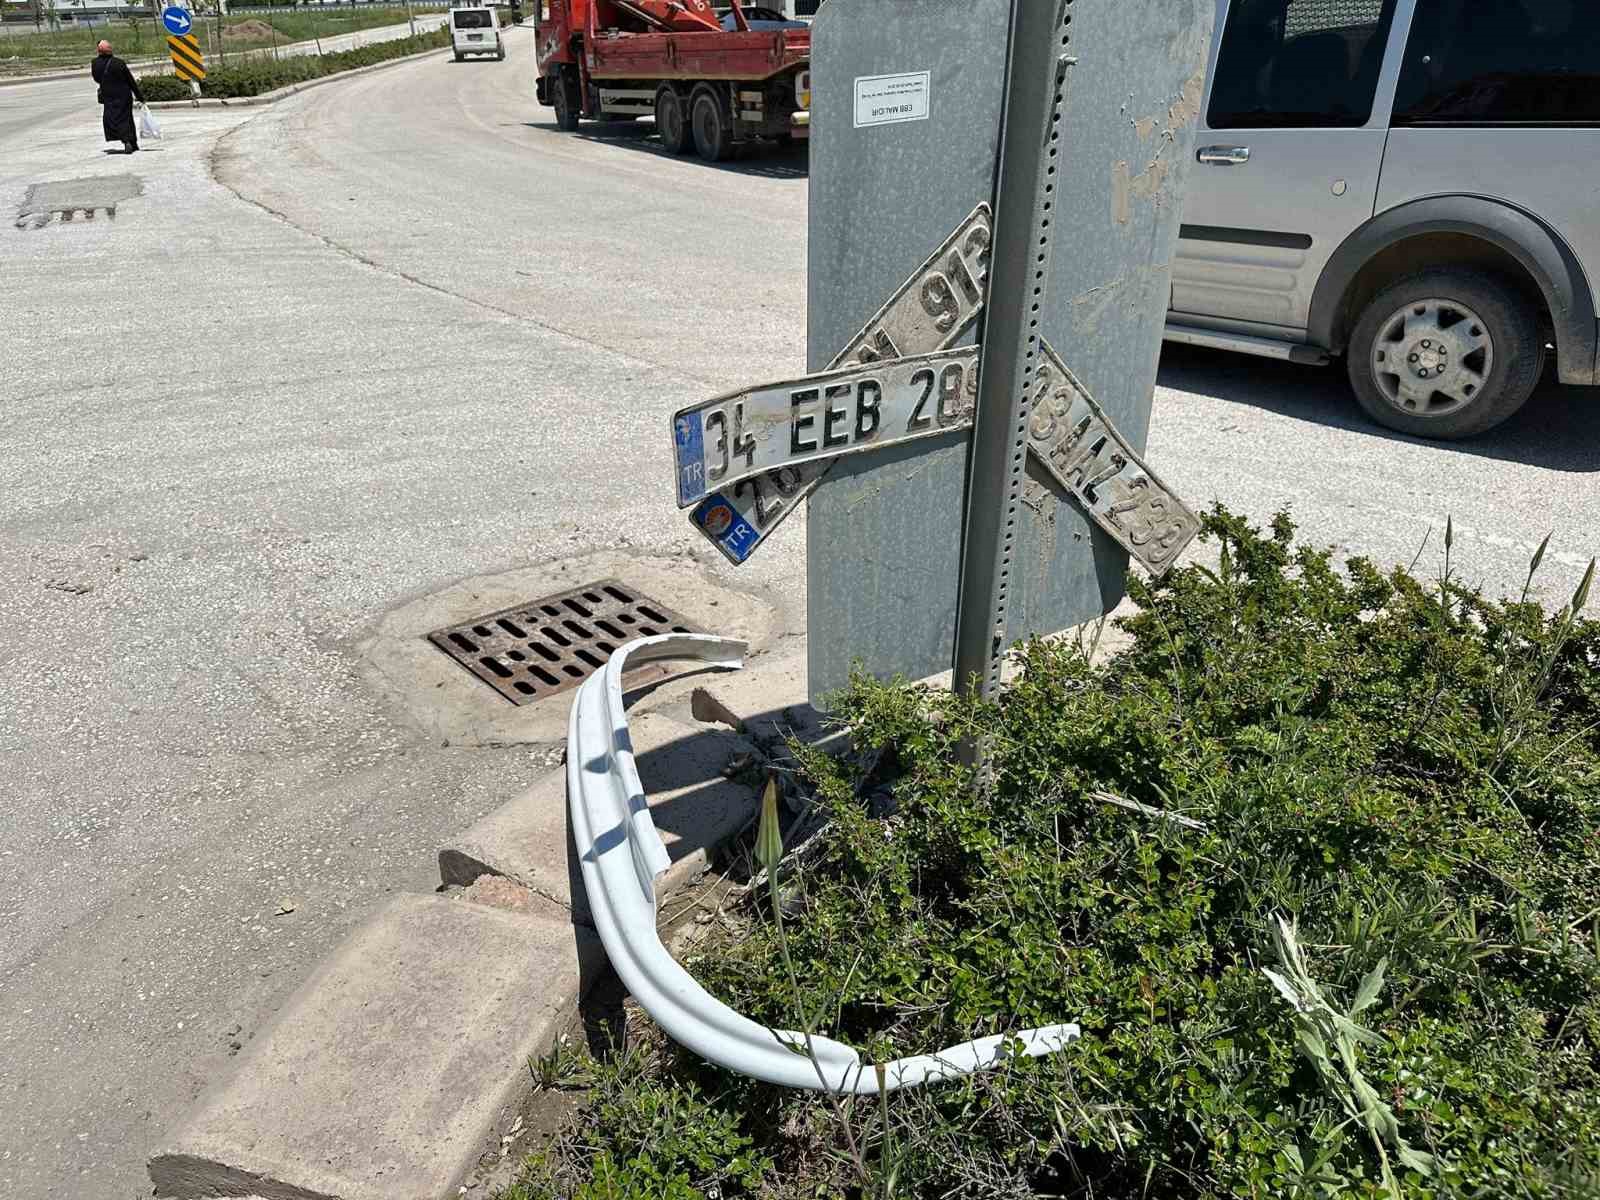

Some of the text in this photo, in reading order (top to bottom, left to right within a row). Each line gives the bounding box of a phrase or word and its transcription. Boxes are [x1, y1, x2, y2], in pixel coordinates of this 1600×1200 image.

[704, 402, 757, 482] 34
[789, 378, 883, 456] EEB
[683, 462, 704, 482] TR
[725, 522, 751, 547] TR
